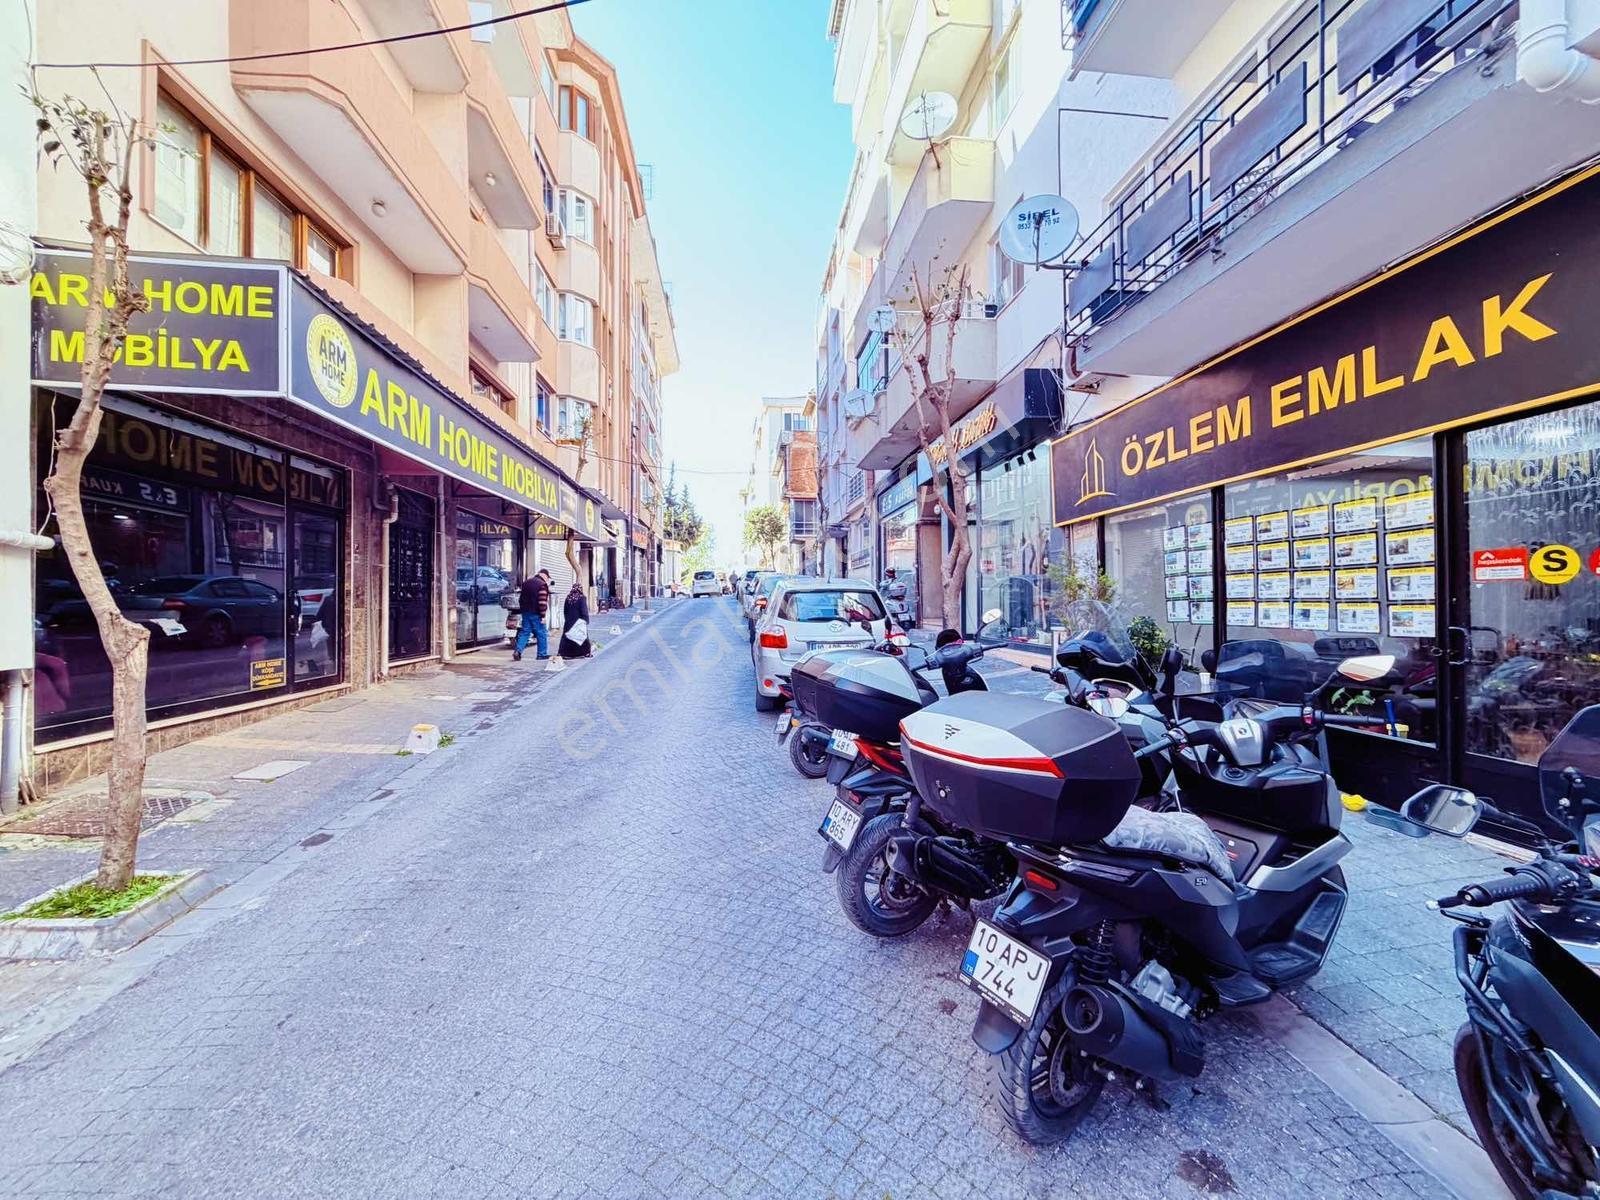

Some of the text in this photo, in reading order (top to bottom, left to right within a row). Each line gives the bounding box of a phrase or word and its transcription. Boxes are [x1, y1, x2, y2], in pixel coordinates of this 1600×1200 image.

[143, 279, 275, 319] HOME
[51, 328, 250, 373] MBİLYA
[319, 335, 347, 372] ARM
[321, 359, 345, 387] HOME
[1121, 396, 1251, 476] ÖZLEM
[1271, 273, 1558, 428] EMLAK
[360, 368, 558, 510] ARM HOME MOBİLYA
[1543, 549, 1568, 572] S
[829, 821, 845, 841] 865
[832, 803, 859, 830] 10 ARY
[978, 928, 998, 953] 10
[982, 961, 1015, 999] 744
